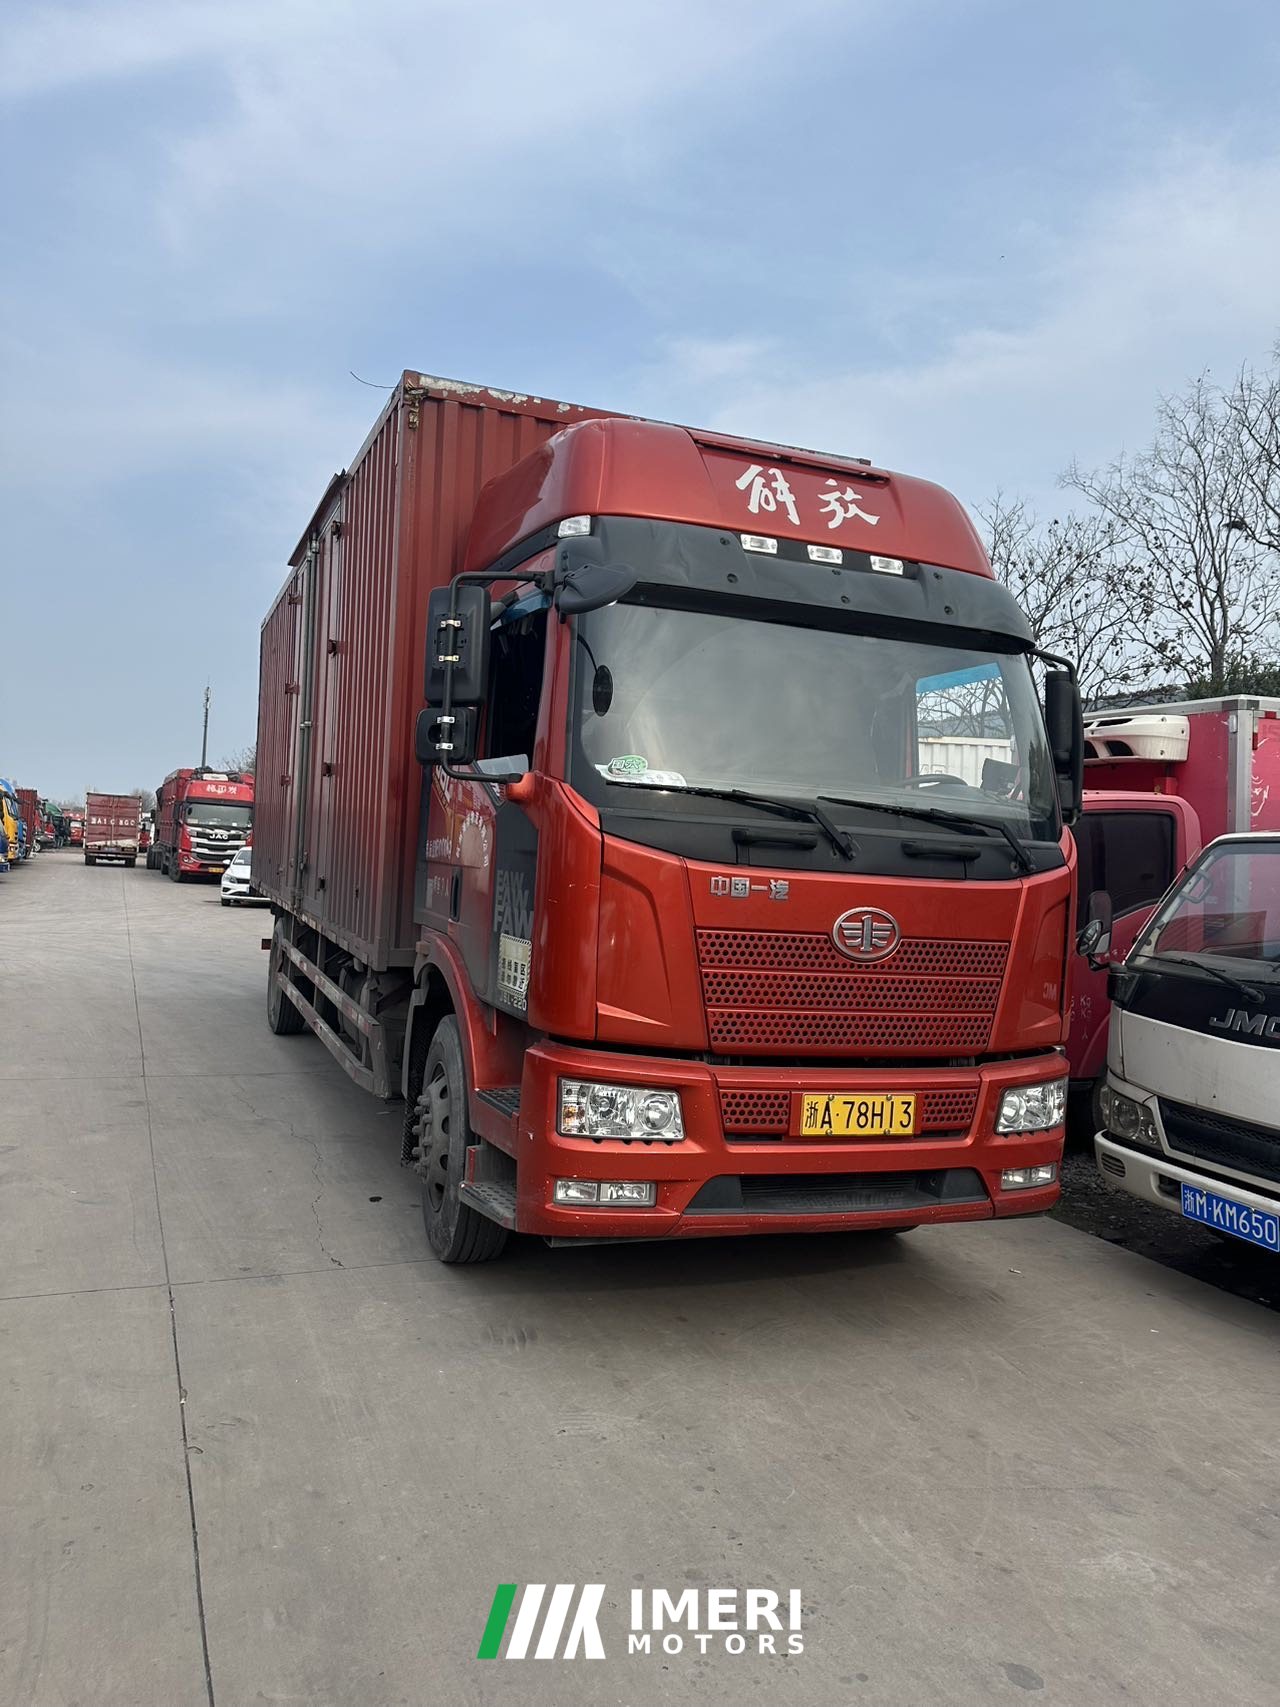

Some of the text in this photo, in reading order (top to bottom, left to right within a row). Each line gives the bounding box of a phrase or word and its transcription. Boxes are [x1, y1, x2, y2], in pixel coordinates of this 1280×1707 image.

[735, 464, 880, 529] 解放
[496, 870, 525, 889] FAW
[710, 876, 790, 900] 中国一汽
[495, 885, 529, 911] FAW
[493, 905, 535, 939] FAW
[1209, 1008, 1280, 1039] JMC
